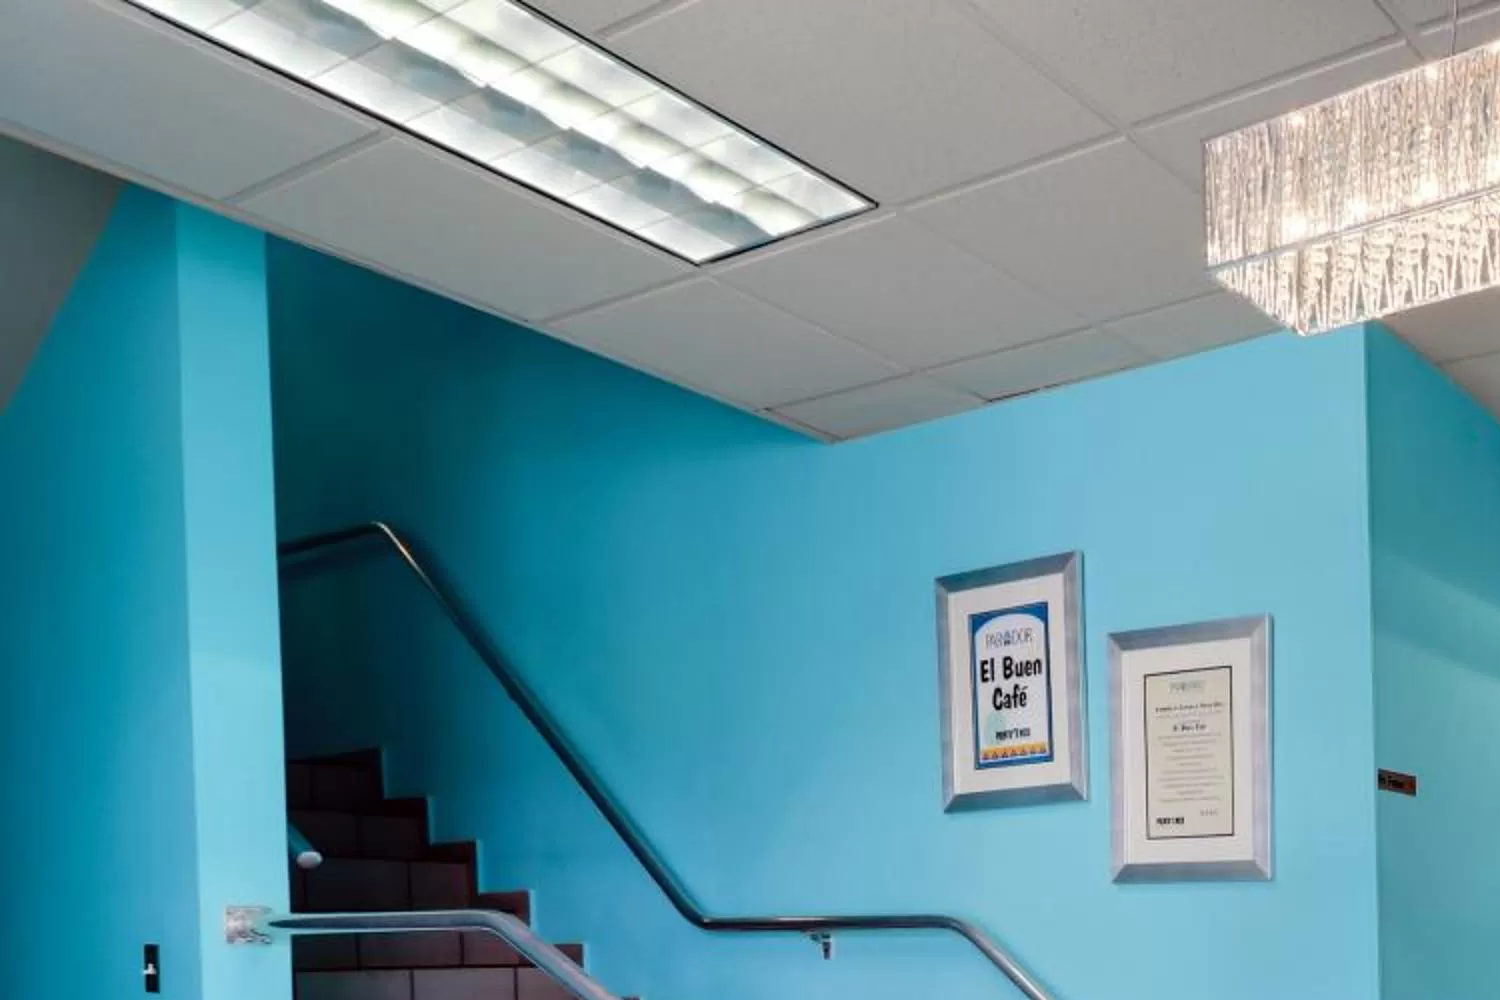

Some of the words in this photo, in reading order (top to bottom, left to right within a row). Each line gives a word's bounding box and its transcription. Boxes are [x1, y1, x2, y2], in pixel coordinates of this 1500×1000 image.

[980, 657, 995, 683] El
[1002, 655, 1042, 680] Buen
[992, 684, 1028, 711] Café
